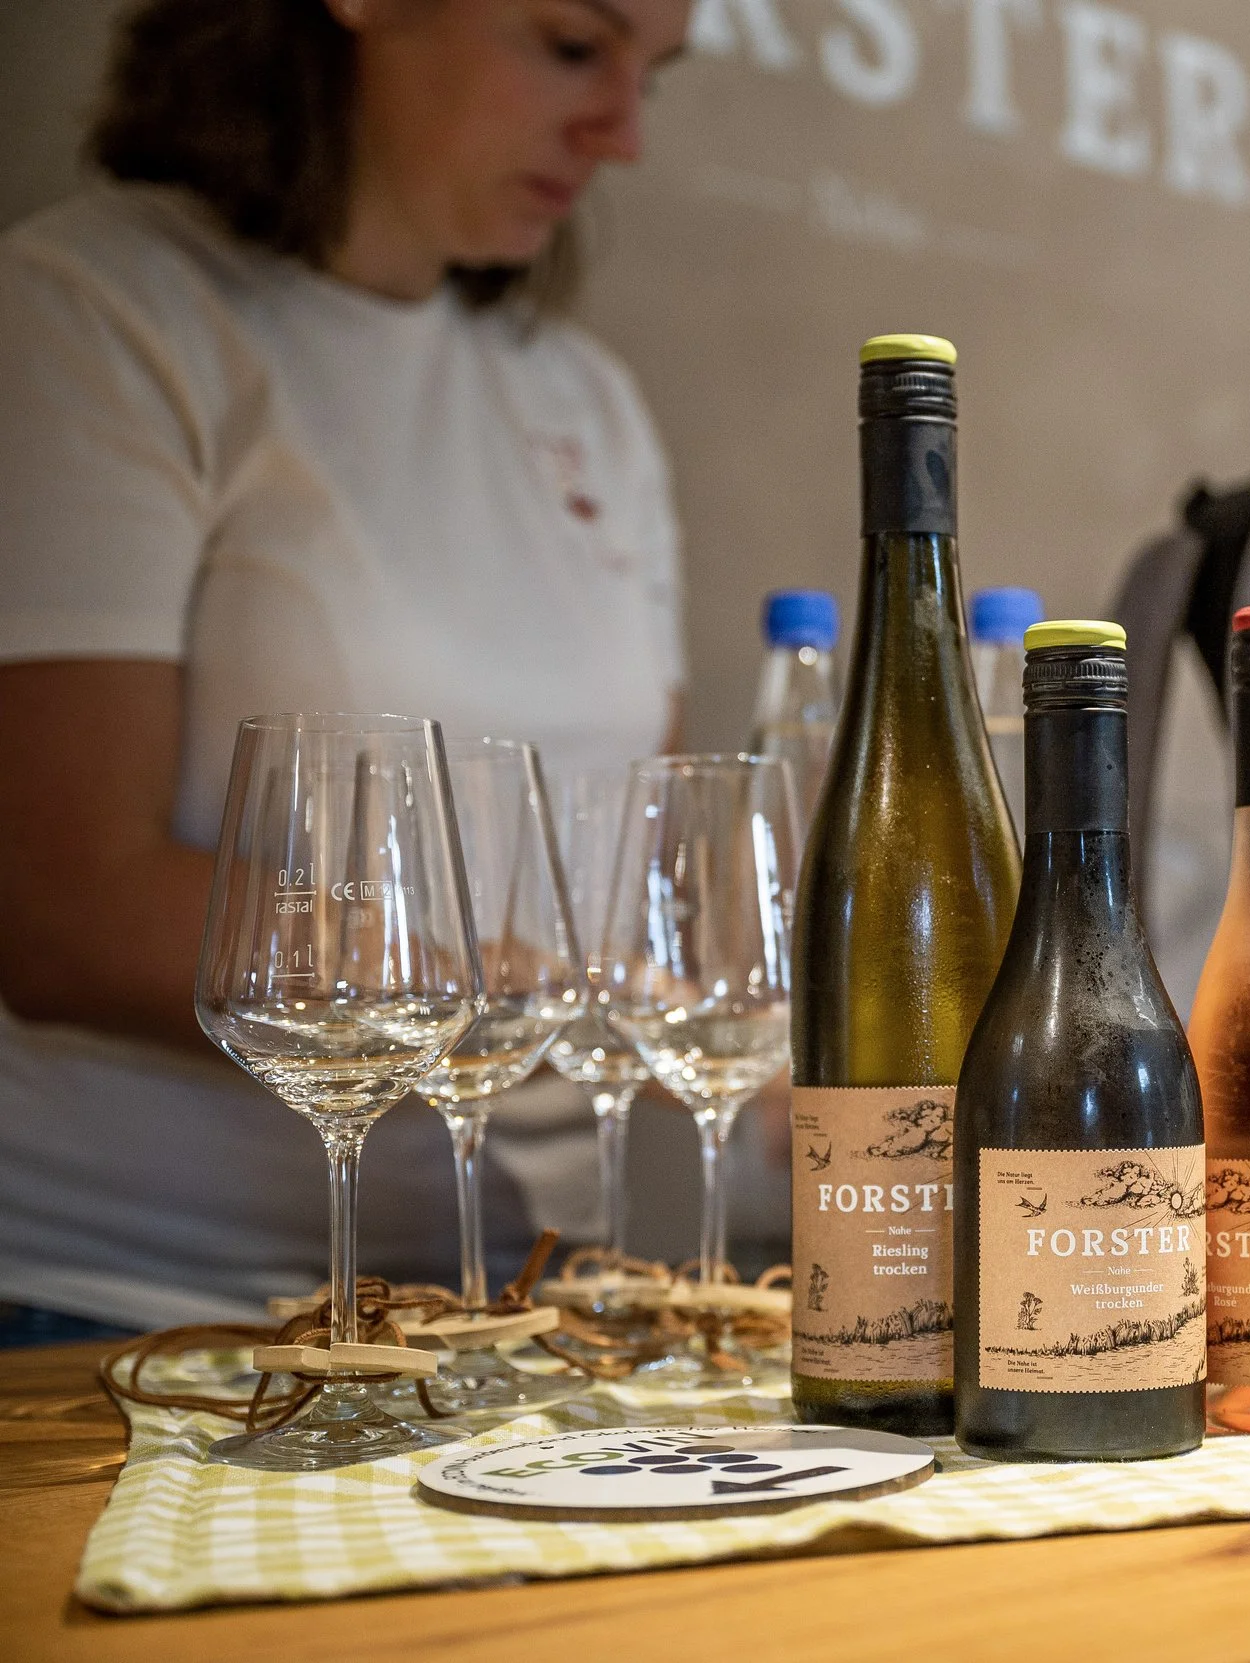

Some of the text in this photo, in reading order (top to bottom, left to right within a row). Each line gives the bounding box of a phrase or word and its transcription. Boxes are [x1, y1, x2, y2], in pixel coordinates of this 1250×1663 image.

[278, 868, 304, 887] 0.2
[364, 885, 375, 897] M
[275, 900, 313, 914] rastal
[274, 950, 299, 969] 0.1
[888, 1226, 912, 1236] Nahe
[1026, 1225, 1191, 1257] FORSTER
[872, 1244, 929, 1259] Riesling
[873, 1263, 927, 1275] trocken
[1107, 1266, 1131, 1276] Nahe
[1070, 1281, 1164, 1297] Weißburgunder
[1095, 1298, 1143, 1310] trocken
[1213, 1296, 1237, 1307] Rosé
[480, 1432, 716, 1479] ECOVIN
